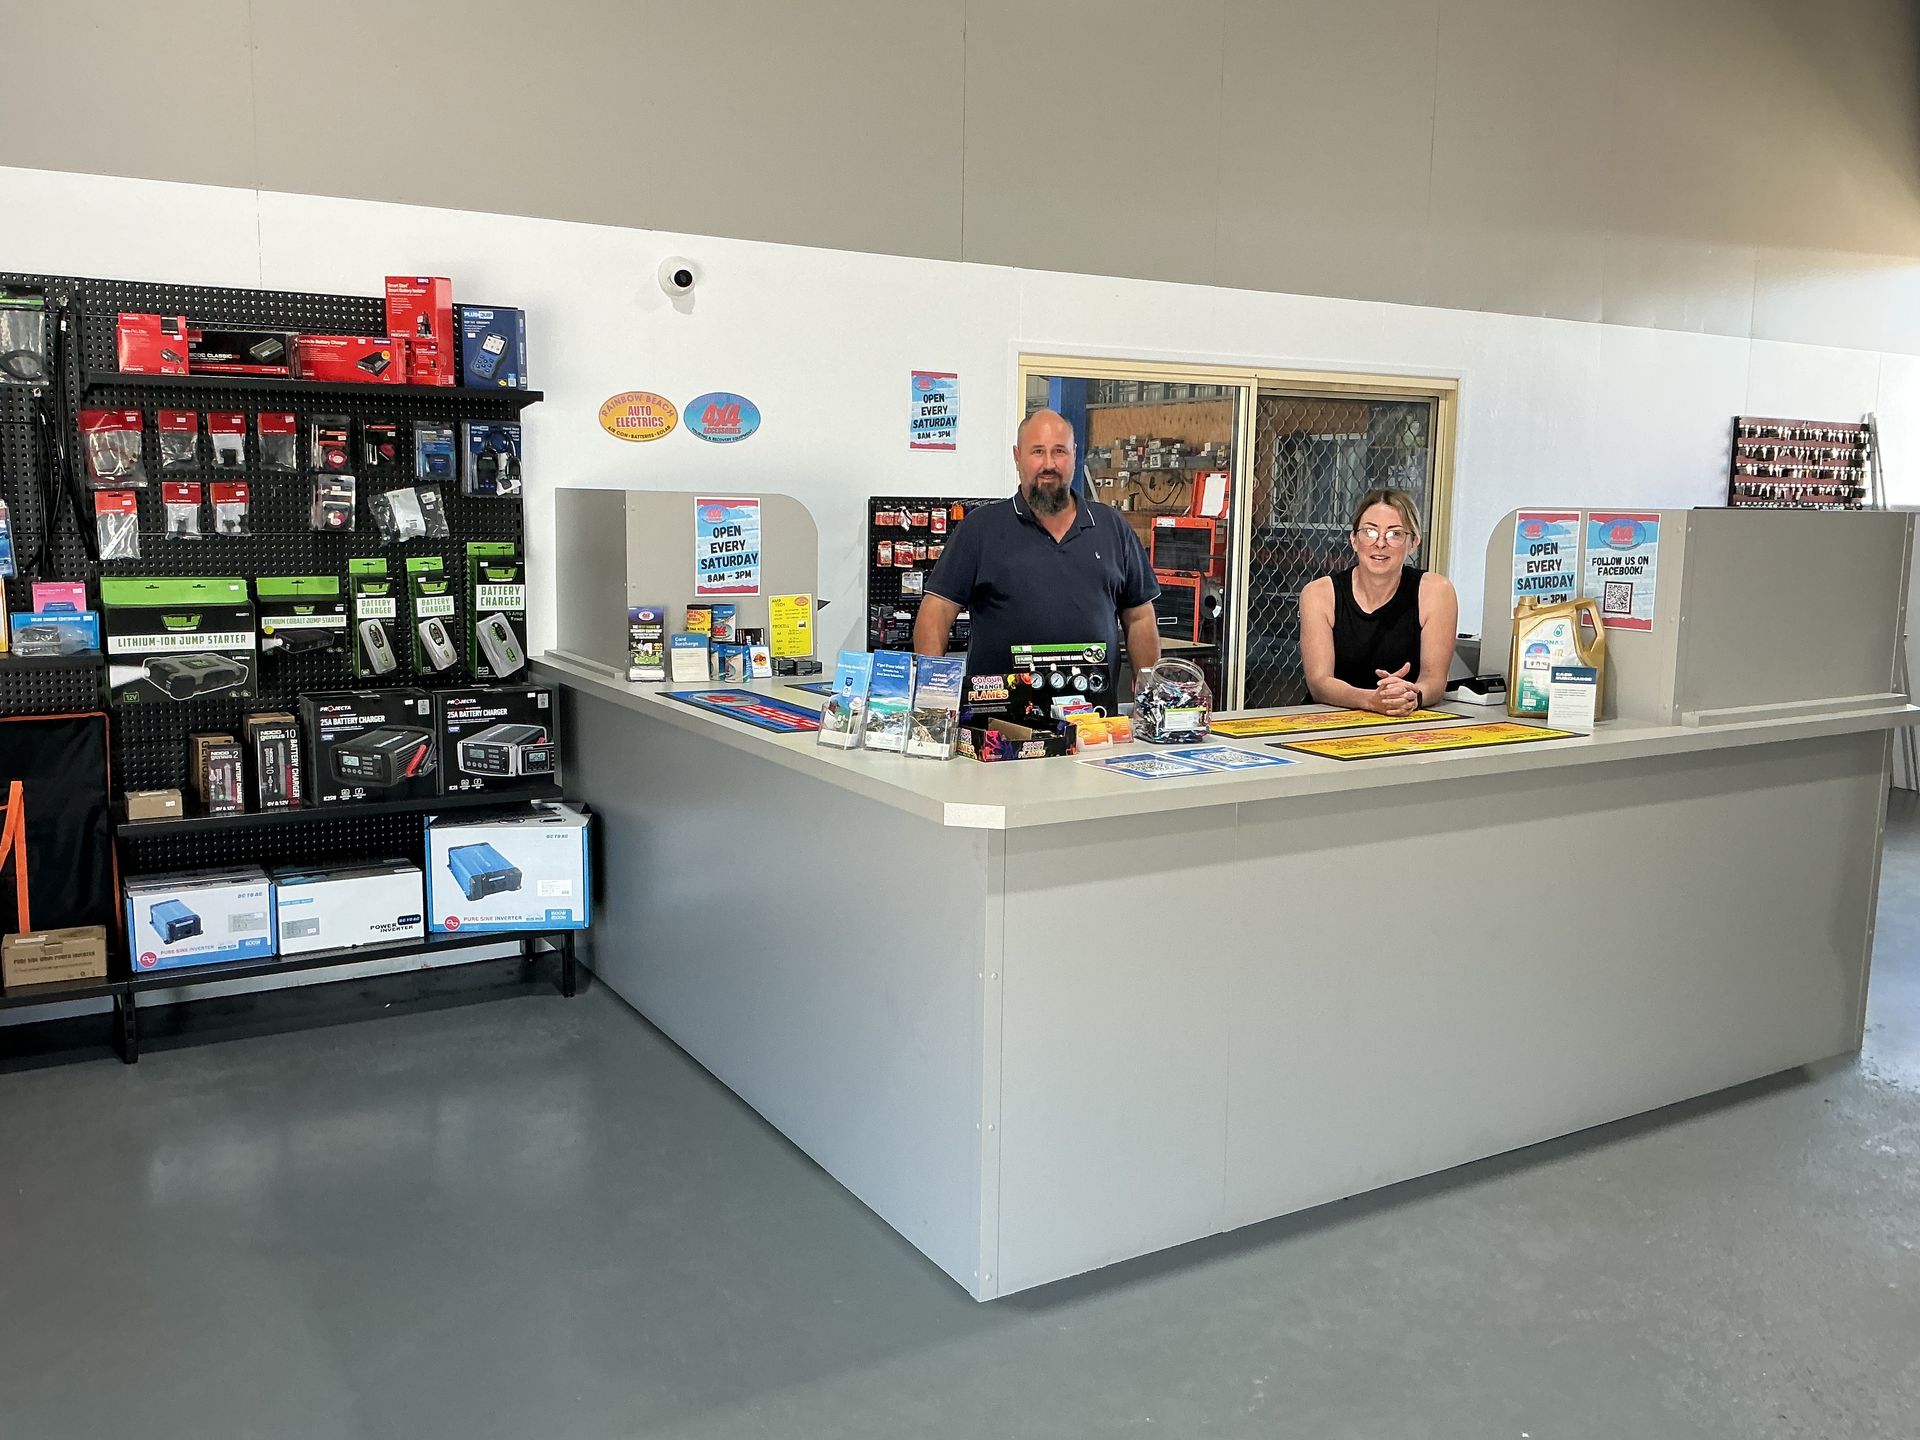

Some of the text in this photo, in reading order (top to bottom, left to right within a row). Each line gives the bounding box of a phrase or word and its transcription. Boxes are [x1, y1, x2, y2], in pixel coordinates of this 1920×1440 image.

[923, 393, 945, 403] OPEN
[601, 394, 674, 417] RAINBOW BEACH
[628, 406, 652, 416] AUTO
[921, 405, 948, 416] EVERY
[616, 417, 664, 428] ELECTRICS
[912, 417, 957, 428] SATURDAY
[713, 525, 742, 538] OPEN
[710, 540, 746, 554] EVERY
[1530, 542, 1558, 556] OPEN
[701, 553, 758, 570] SATURDAY
[1527, 559, 1562, 574] EVERY
[1592, 556, 1649, 566] FOLLOW US ON
[708, 573, 725, 582] 8AM
[735, 570, 752, 579] 3PM
[1598, 566, 1643, 576] FACEBOOK!
[1517, 575, 1574, 590] SATURDAY
[481, 586, 520, 596] BATTERY
[481, 597, 520, 606] CHARGER
[1550, 594, 1567, 604] 3PM
[421, 605, 451, 613] CHARGER
[118, 634, 247, 648] LITHIUM-ION JUMP STARTER
[972, 676, 1002, 684] COLOUR
[968, 690, 1009, 700] FLAMES
[333, 717, 358, 725] BATTERY
[359, 715, 385, 723] CHARGER
[285, 729, 296, 738] 10
[290, 739, 300, 798] BATTERY CHARGER
